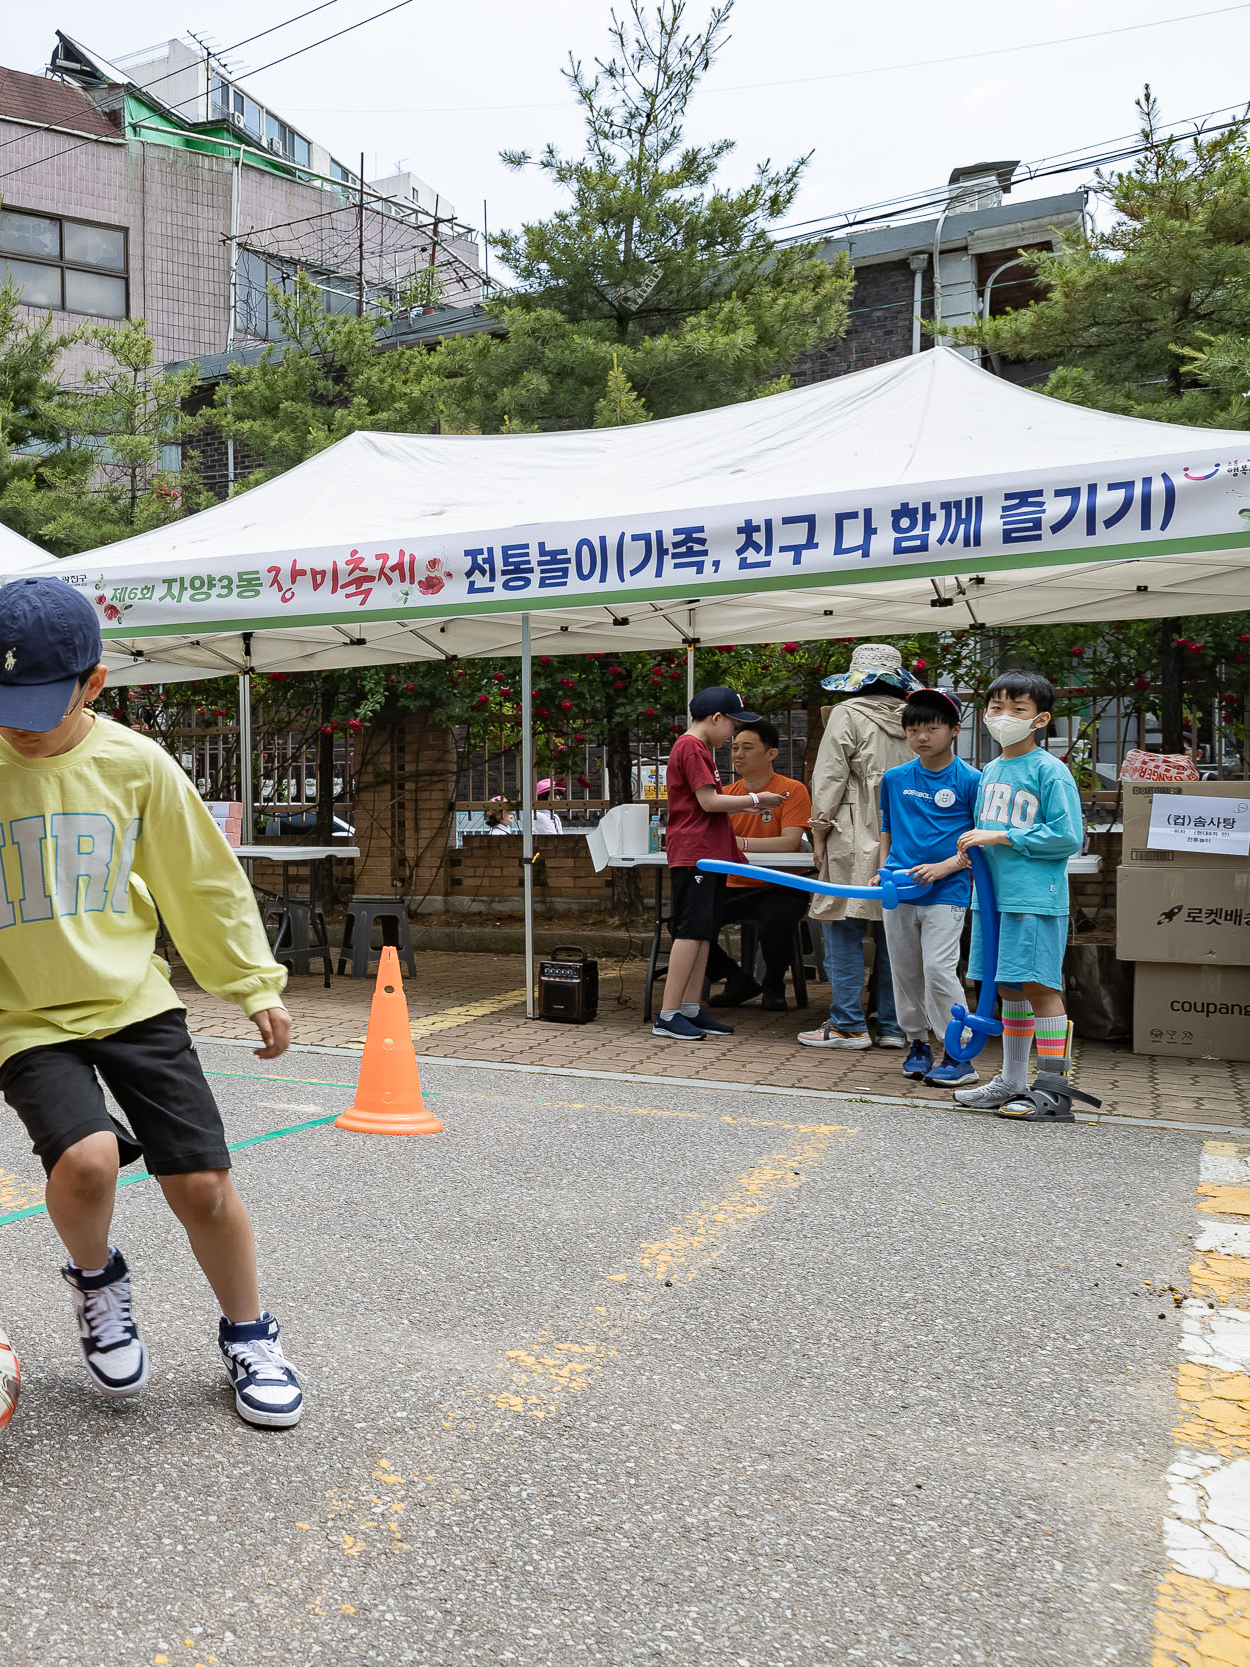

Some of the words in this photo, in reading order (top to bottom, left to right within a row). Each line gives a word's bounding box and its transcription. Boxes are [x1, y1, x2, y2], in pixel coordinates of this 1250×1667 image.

[110, 584, 155, 603] 제6회
[158, 570, 263, 603] 자양3동
[267, 549, 417, 605] 장미축제
[464, 526, 720, 594] 전통놀이(가족,
[736, 514, 818, 570] 친구
[833, 508, 878, 558] 다
[892, 496, 982, 555] 함께
[1001, 472, 1176, 545] 즐기기)
[1167, 814, 1237, 830] (컵)솜사탕
